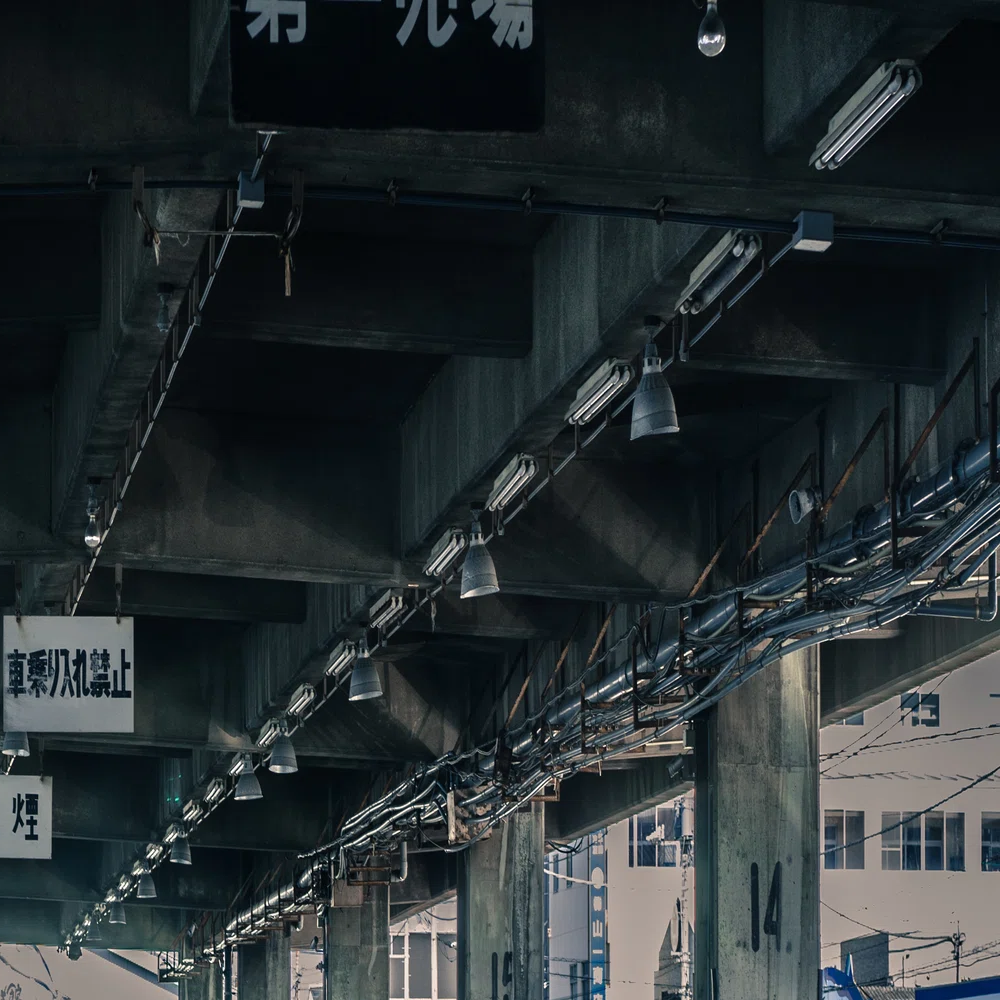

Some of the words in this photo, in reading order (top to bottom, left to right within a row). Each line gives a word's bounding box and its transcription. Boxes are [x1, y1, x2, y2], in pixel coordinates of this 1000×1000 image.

[6, 648, 132, 699] 車乗り入れ禁止
[751, 861, 782, 953] 14
